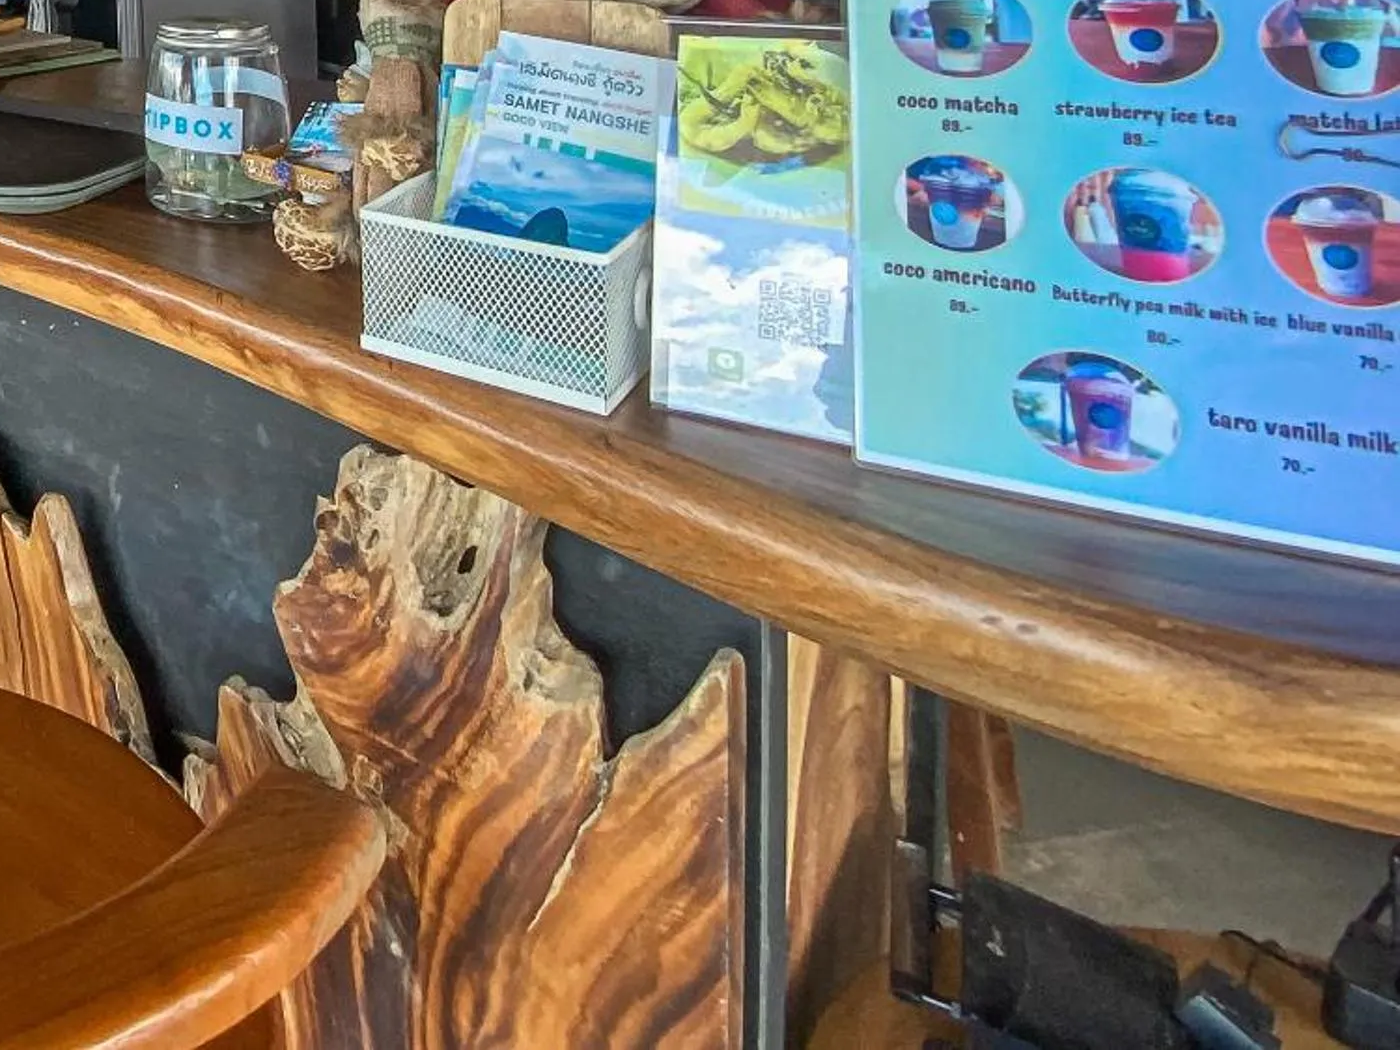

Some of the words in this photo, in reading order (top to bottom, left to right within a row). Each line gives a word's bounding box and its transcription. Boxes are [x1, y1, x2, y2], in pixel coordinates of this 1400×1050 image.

[504, 93, 561, 116] SAMET
[565, 105, 652, 135] NANGSHE
[896, 94, 939, 110] coco
[944, 96, 1020, 116] matcha
[1054, 101, 1164, 127] strawberry
[1171, 106, 1198, 125] ice
[1205, 108, 1238, 128] tea
[883, 261, 926, 280] coco
[932, 268, 1037, 294] americano
[1051, 284, 1130, 313] Butterfly
[1135, 299, 1164, 316] pea
[1169, 302, 1205, 320] milk
[1209, 306, 1248, 325] with
[1253, 310, 1278, 328] ice
[1287, 313, 1327, 334] blue
[1332, 322, 1395, 342] vanilla
[1207, 407, 1257, 433] taro
[1264, 421, 1340, 447] vanilla
[1347, 430, 1399, 455] milk
